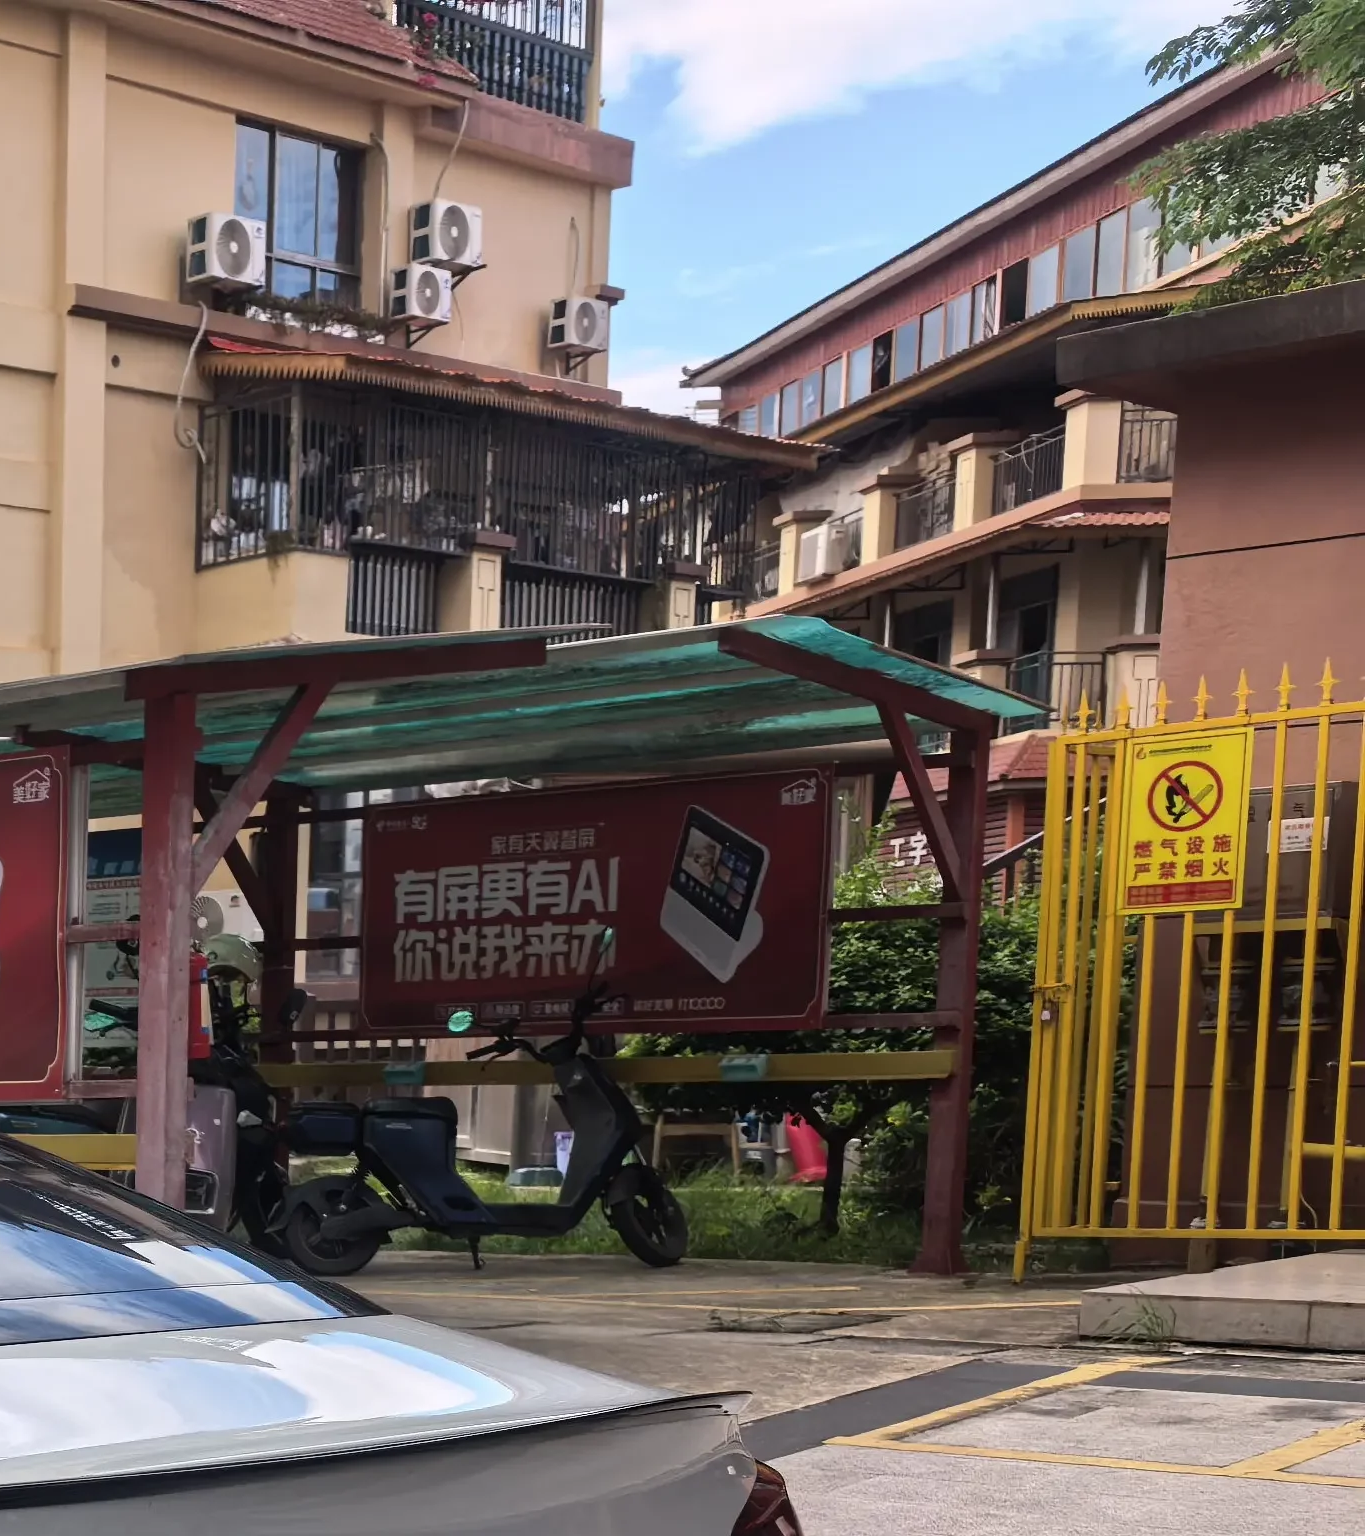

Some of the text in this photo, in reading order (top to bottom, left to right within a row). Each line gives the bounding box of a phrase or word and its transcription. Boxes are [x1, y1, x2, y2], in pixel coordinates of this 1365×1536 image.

[491, 828, 596, 855] 家有天翼智屏
[1133, 834, 1233, 859] 燃气设施
[1133, 857, 1231, 882] 严禁烟火
[393, 856, 620, 924] 有屏更有AI
[393, 919, 618, 983] 你说我来办
